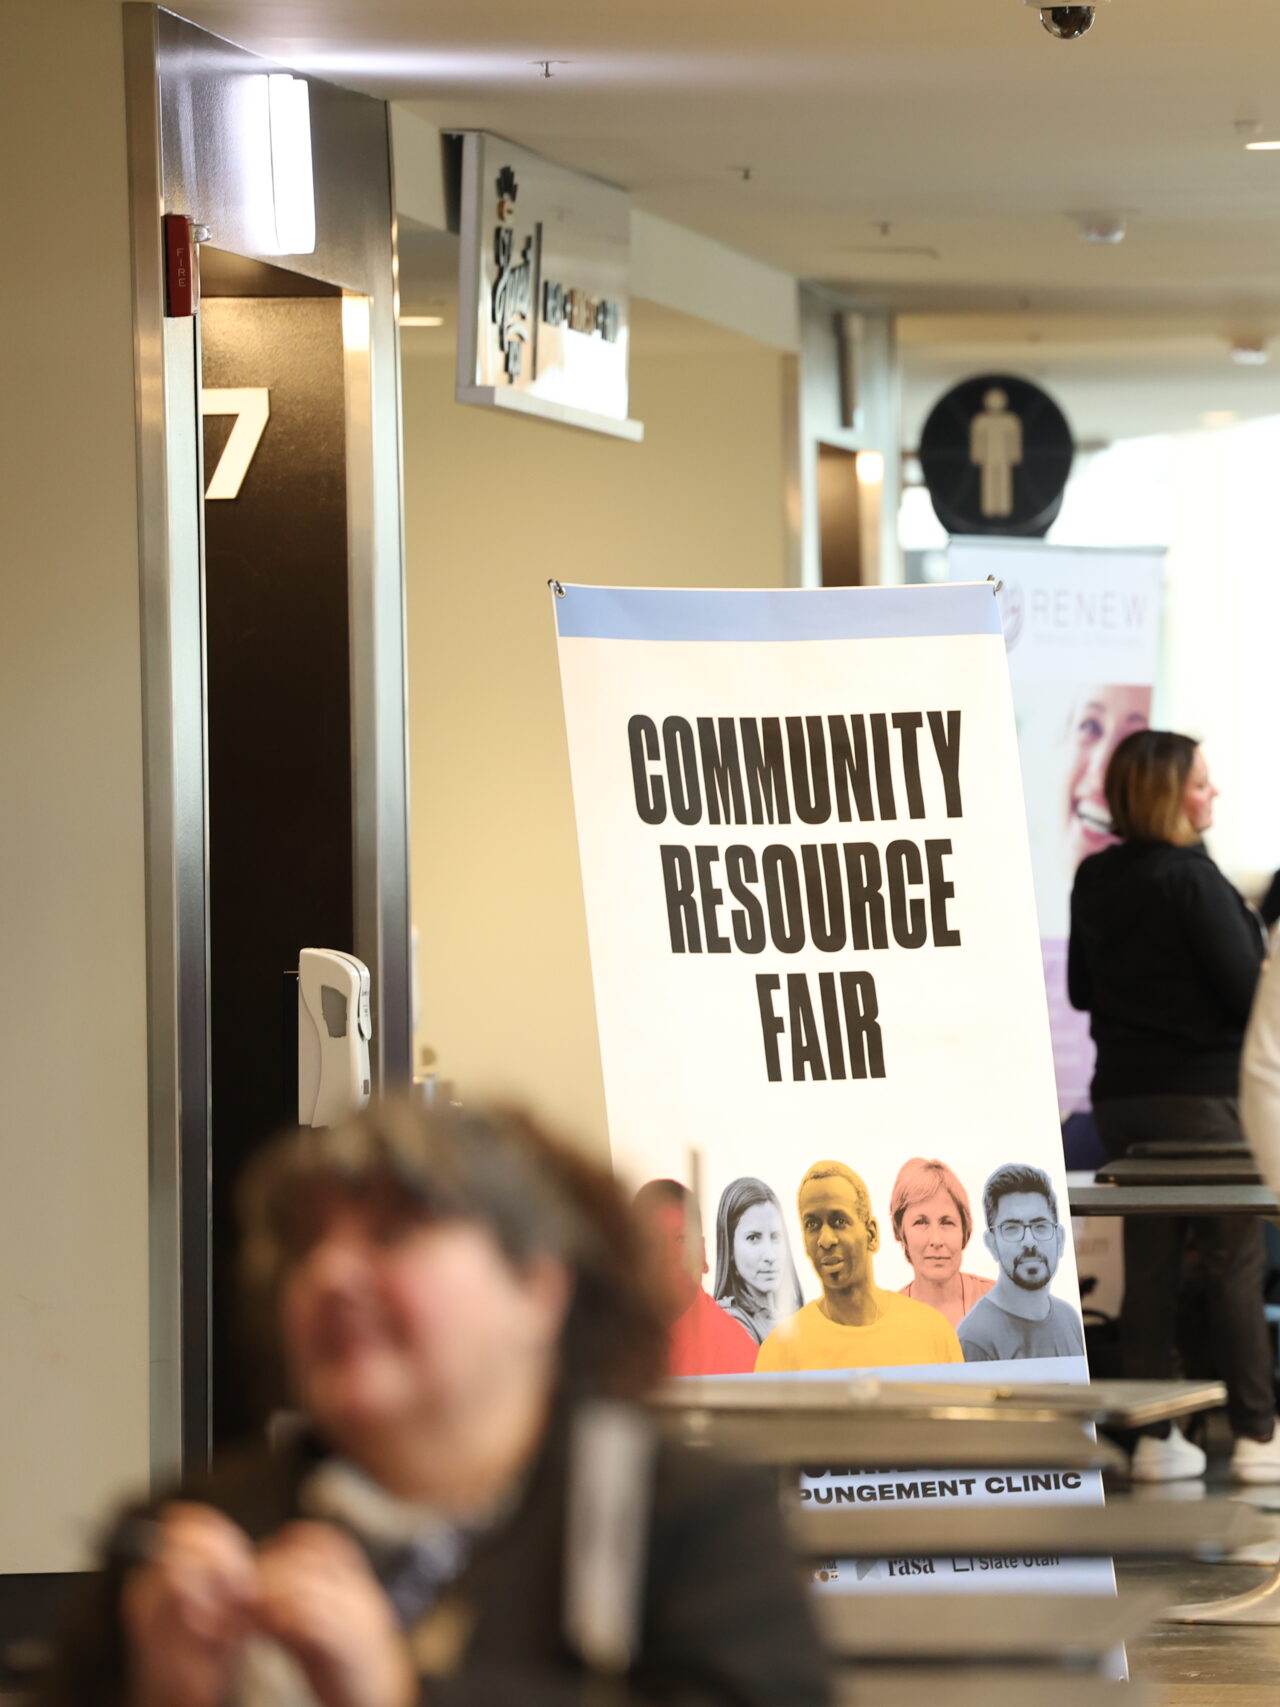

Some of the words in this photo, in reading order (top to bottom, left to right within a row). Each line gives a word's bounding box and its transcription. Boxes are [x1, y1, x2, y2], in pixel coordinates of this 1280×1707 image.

[176, 247, 187, 288] FIRE
[202, 387, 270, 500] 7
[1031, 588, 1149, 629] RENEW
[627, 709, 964, 826] COMMUNITY
[659, 838, 962, 955] RESOURCE
[755, 970, 887, 1082] FAIR
[984, 1471, 1082, 1494] CLINIC
[887, 1556, 936, 1577] rasa
